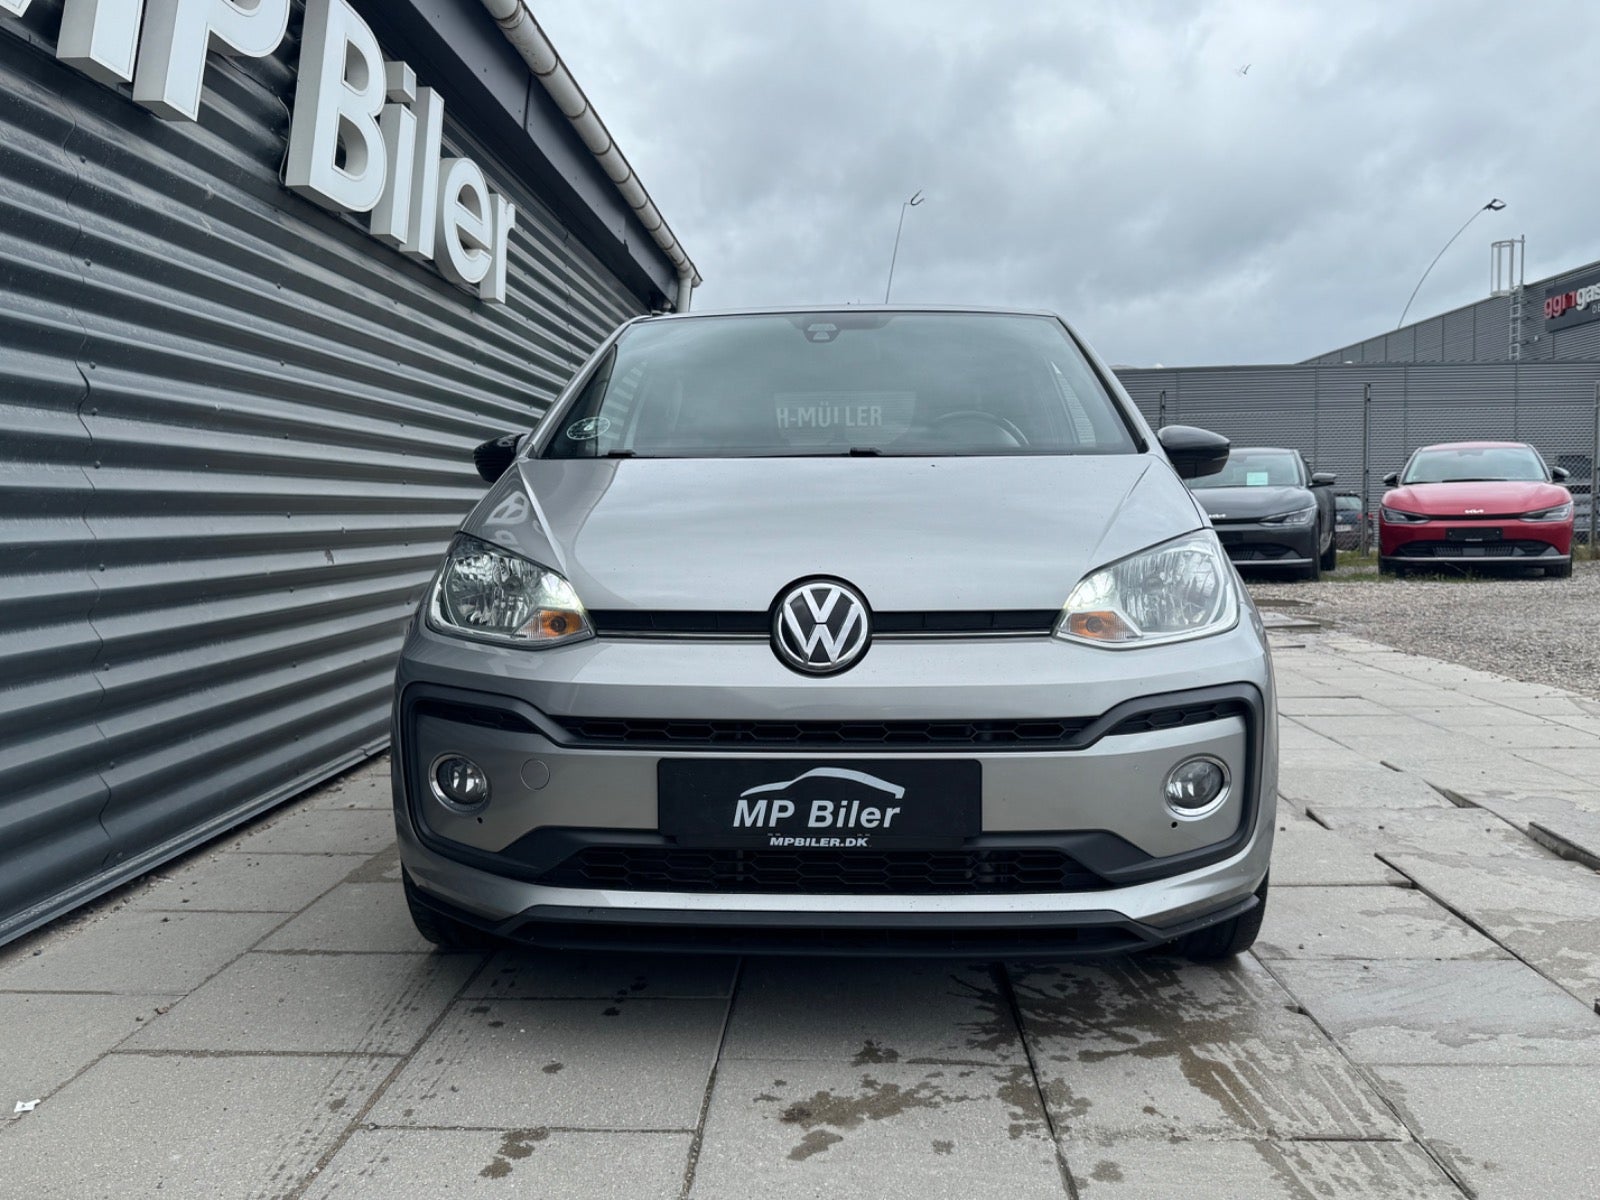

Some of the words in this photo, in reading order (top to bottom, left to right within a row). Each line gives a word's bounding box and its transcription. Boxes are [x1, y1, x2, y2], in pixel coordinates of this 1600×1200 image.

[286, 0, 516, 304] Biler
[782, 585, 866, 666] VW
[733, 799, 795, 828] MP
[808, 799, 900, 829] Biler
[769, 837, 869, 847] MPBILER.DK
